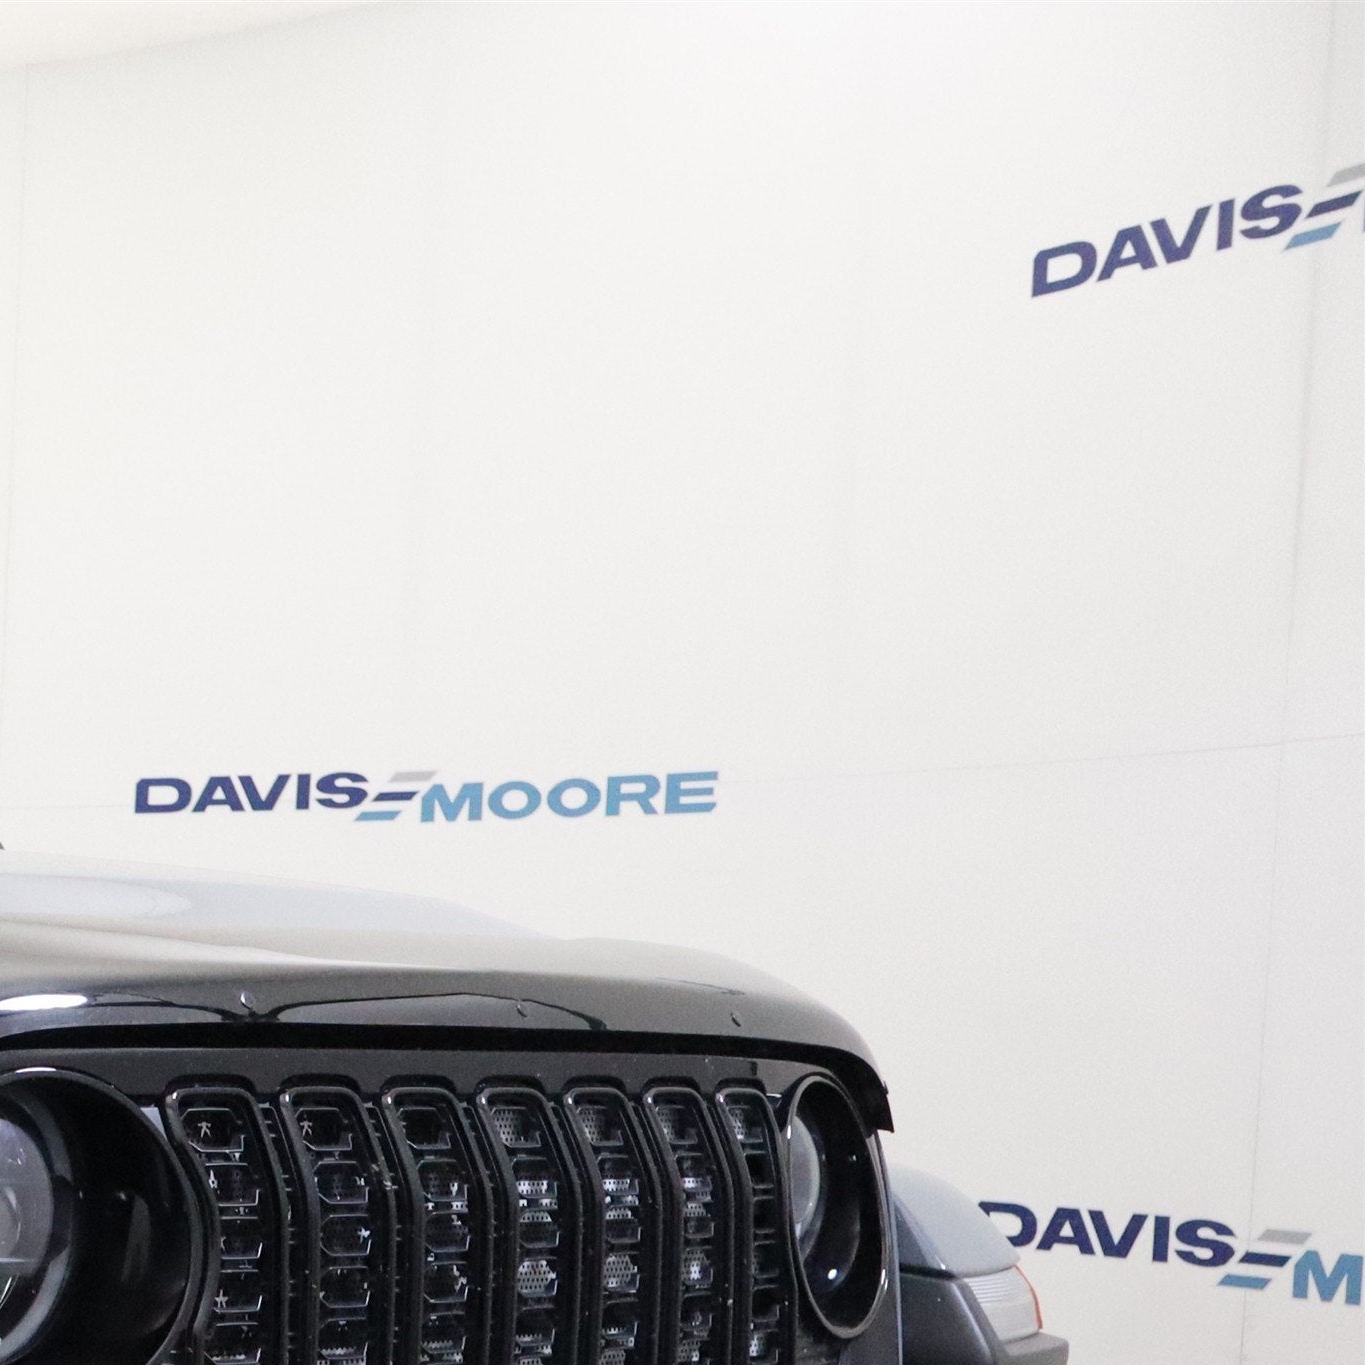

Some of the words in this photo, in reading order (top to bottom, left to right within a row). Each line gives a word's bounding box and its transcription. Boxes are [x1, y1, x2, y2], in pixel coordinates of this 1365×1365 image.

[1032, 184, 1303, 297] DAVIS
[134, 771, 369, 815] DAVIS
[420, 770, 719, 823] MOORE
[978, 1200, 1236, 1268] DAVIS
